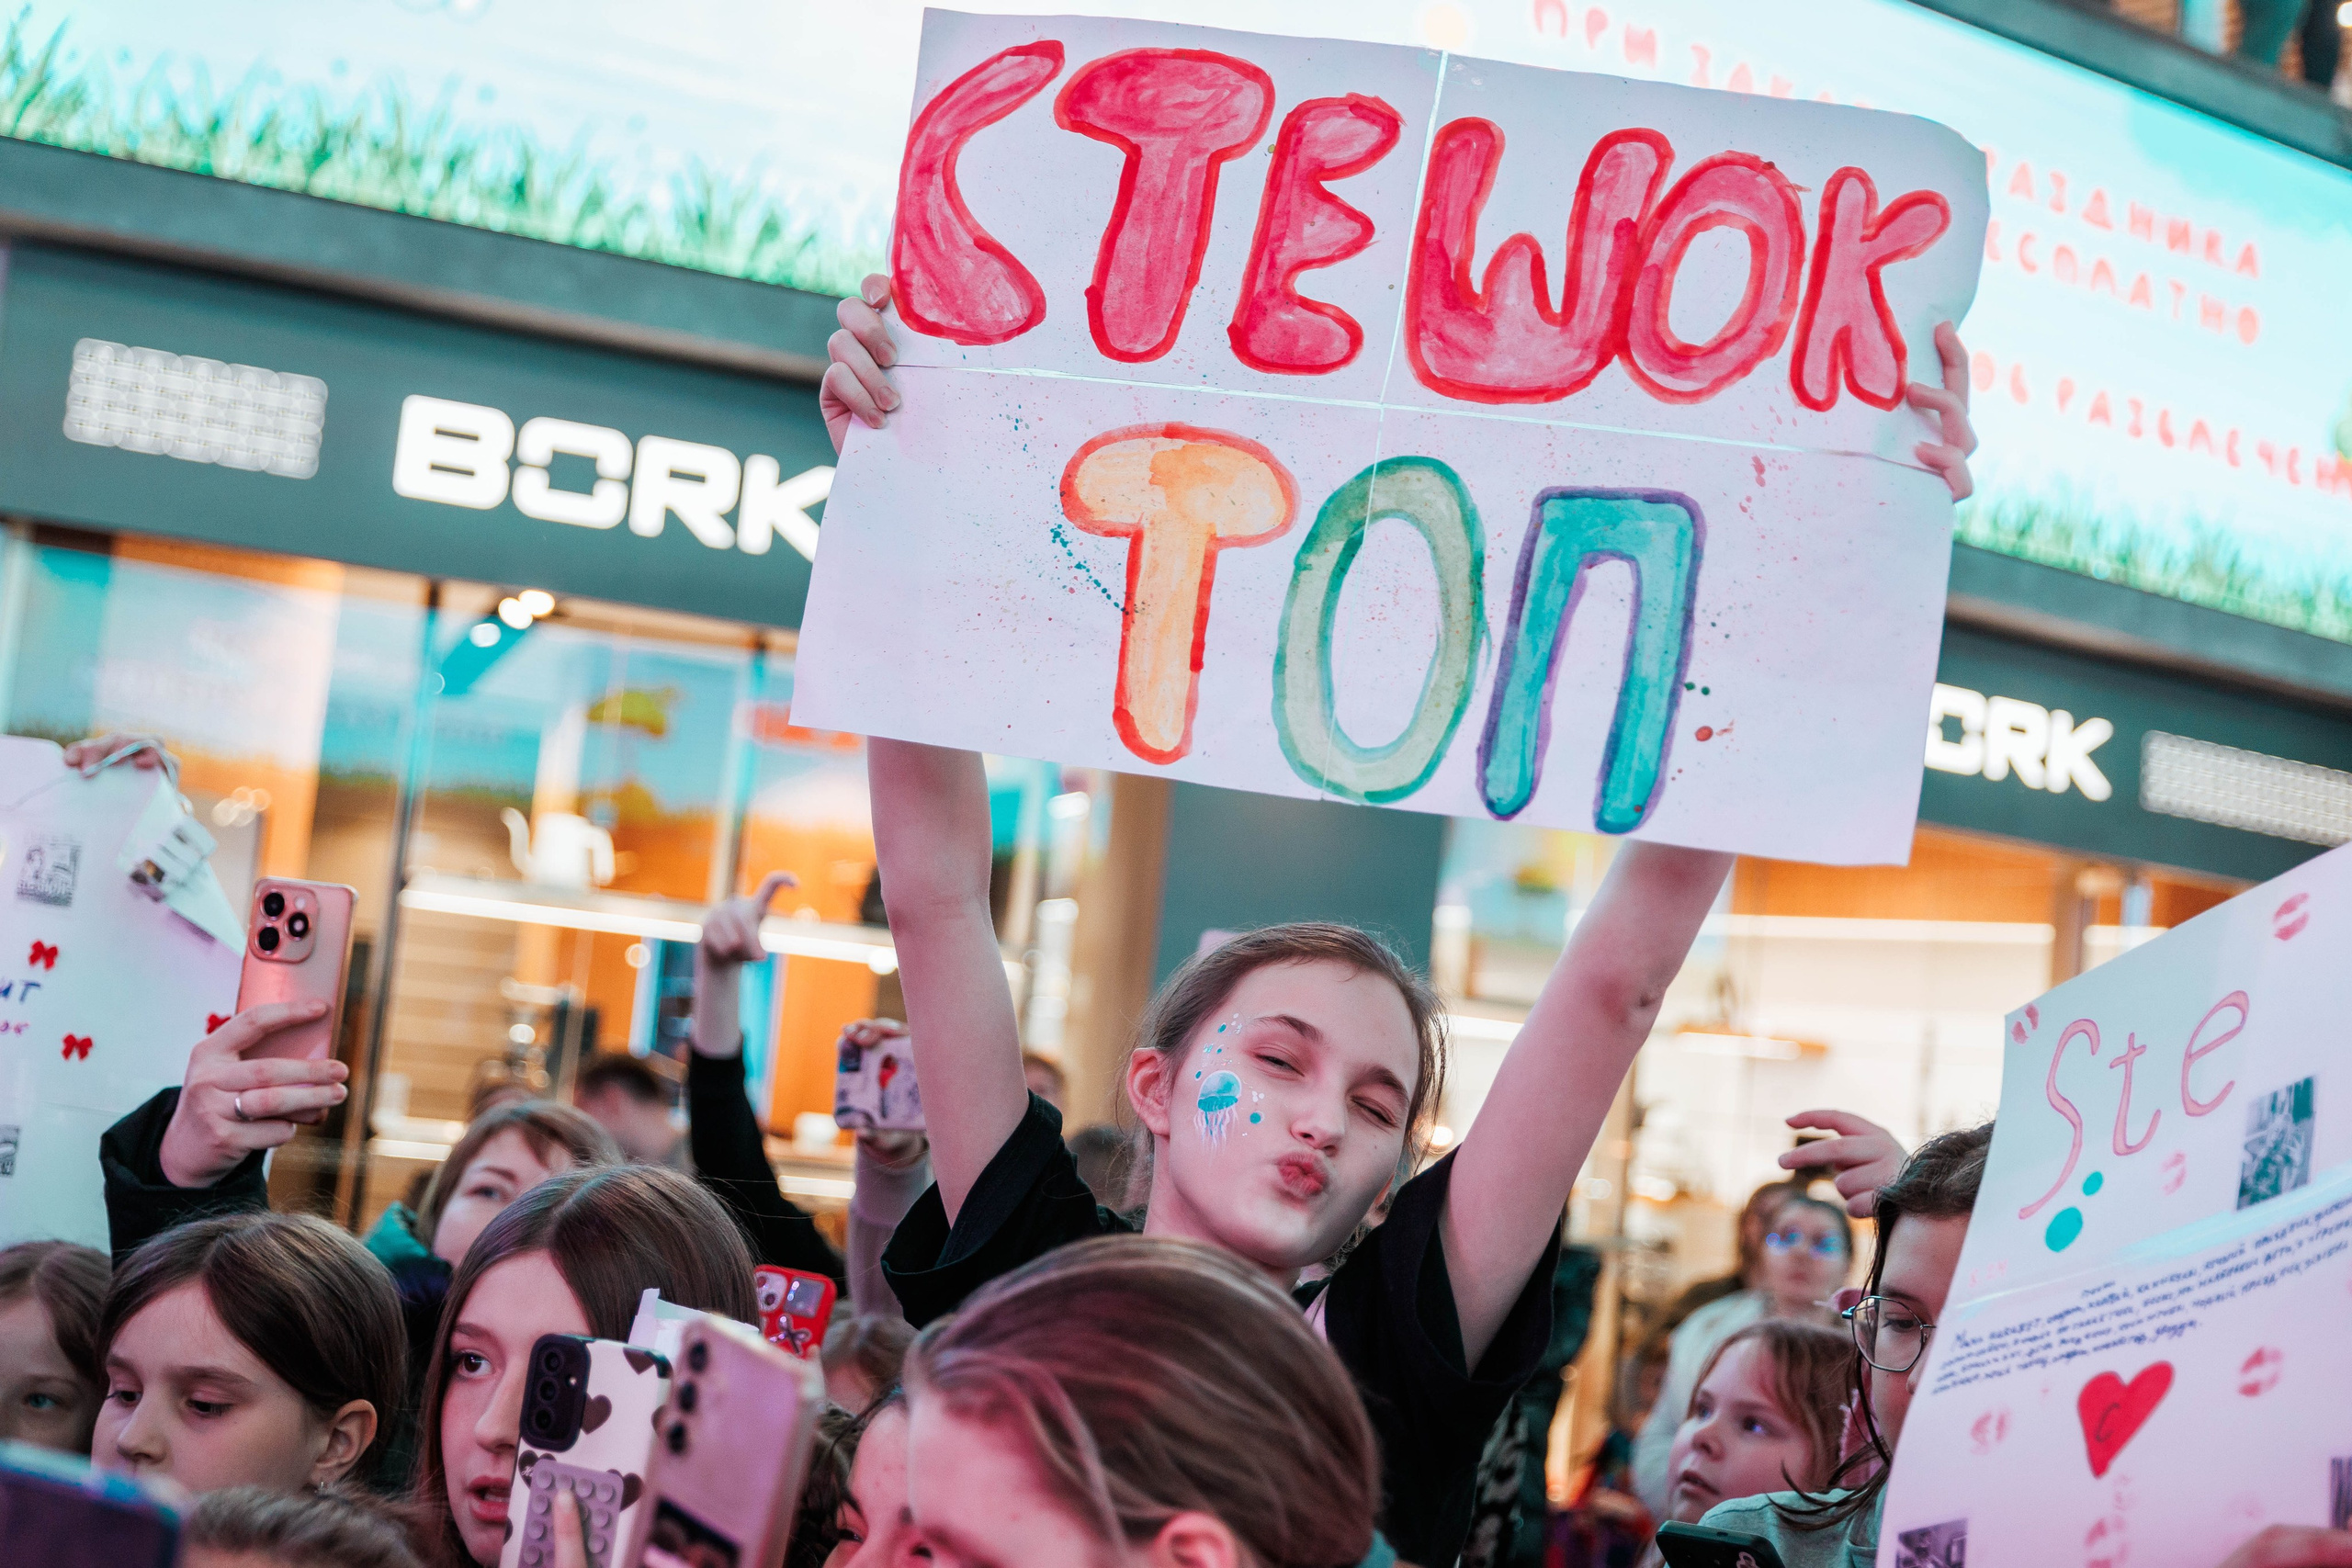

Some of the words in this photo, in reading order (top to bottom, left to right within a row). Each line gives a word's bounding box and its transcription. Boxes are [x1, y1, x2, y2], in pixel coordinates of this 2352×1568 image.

[890, 39, 1951, 412] STEWOK
[392, 394, 831, 564] BORK
[1059, 422, 1709, 836] ТОП
[2018, 989, 2251, 1221] Ste
